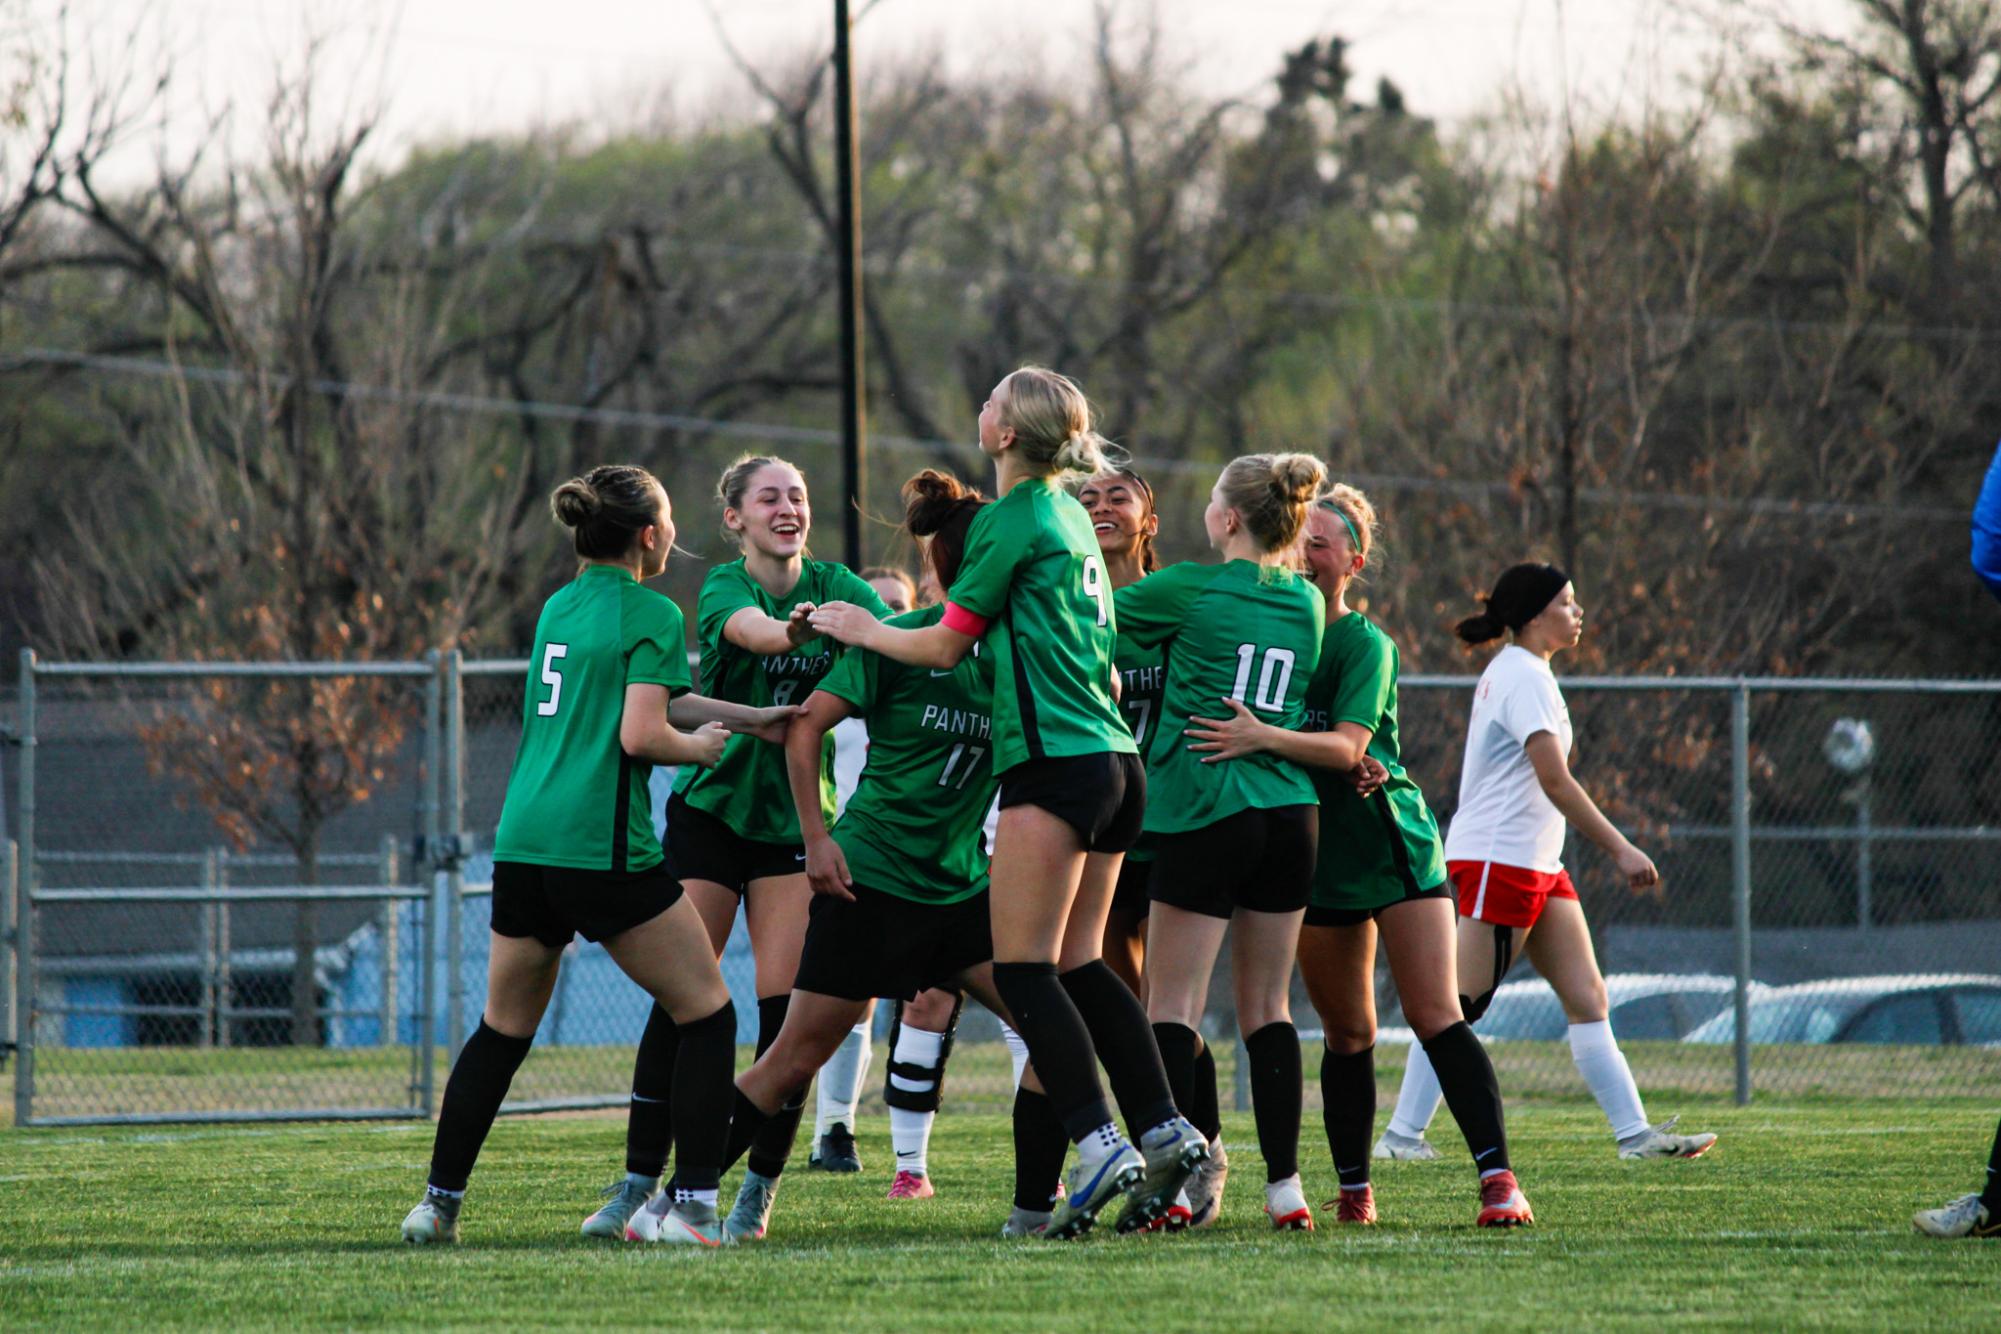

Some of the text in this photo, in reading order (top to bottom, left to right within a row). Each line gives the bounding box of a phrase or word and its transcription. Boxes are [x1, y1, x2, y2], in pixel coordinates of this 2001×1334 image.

[1083, 555, 1107, 627] 9
[537, 642, 568, 717] 5
[1231, 643, 1296, 712] 10
[921, 704, 993, 741] PANTH
[1128, 699, 1151, 745] 7
[938, 743, 985, 790] 17
